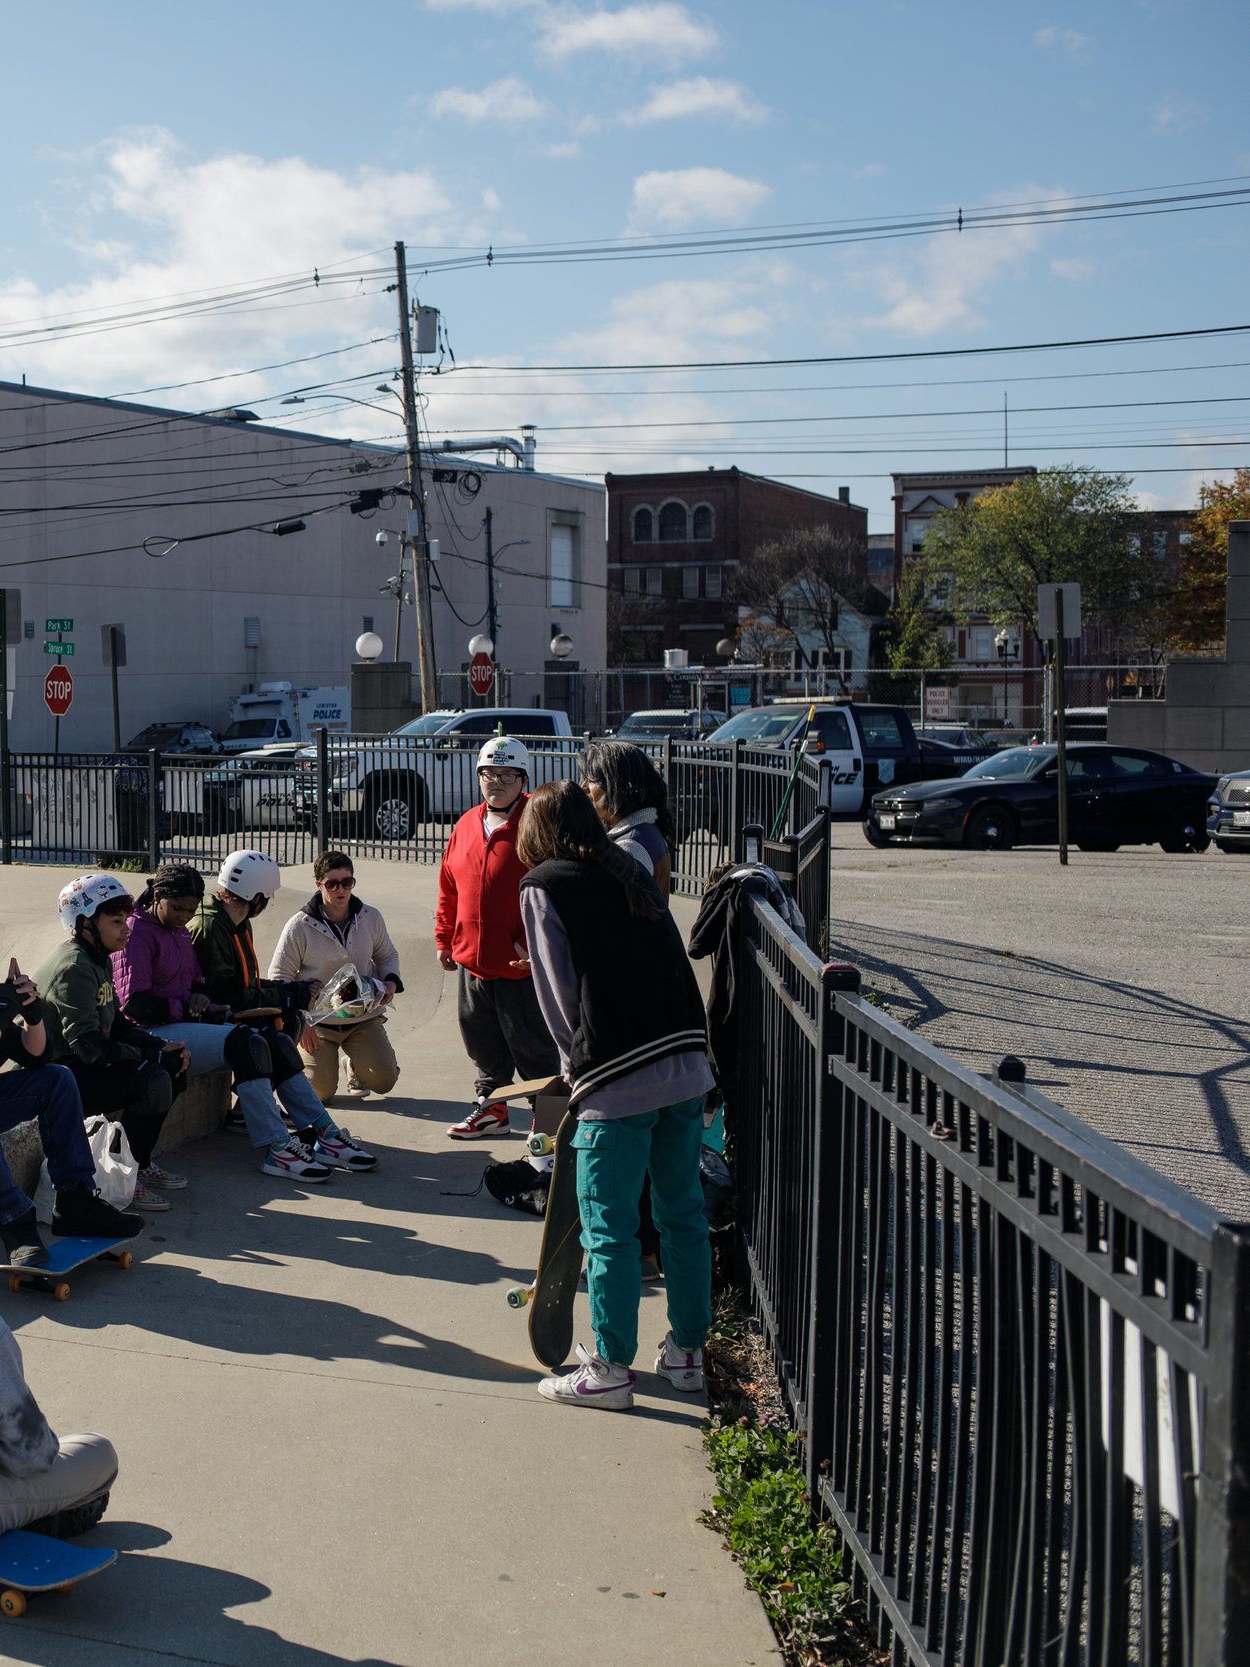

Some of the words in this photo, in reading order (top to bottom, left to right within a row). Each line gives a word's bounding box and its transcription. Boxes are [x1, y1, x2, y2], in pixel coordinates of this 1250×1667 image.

[48, 621, 60, 630] Park
[64, 621, 71, 630] St
[47, 643, 63, 654] Spruce
[66, 645, 73, 655] St
[471, 665, 492, 682] STOP
[46, 680, 72, 699] STOP
[313, 709, 342, 719] POLICE
